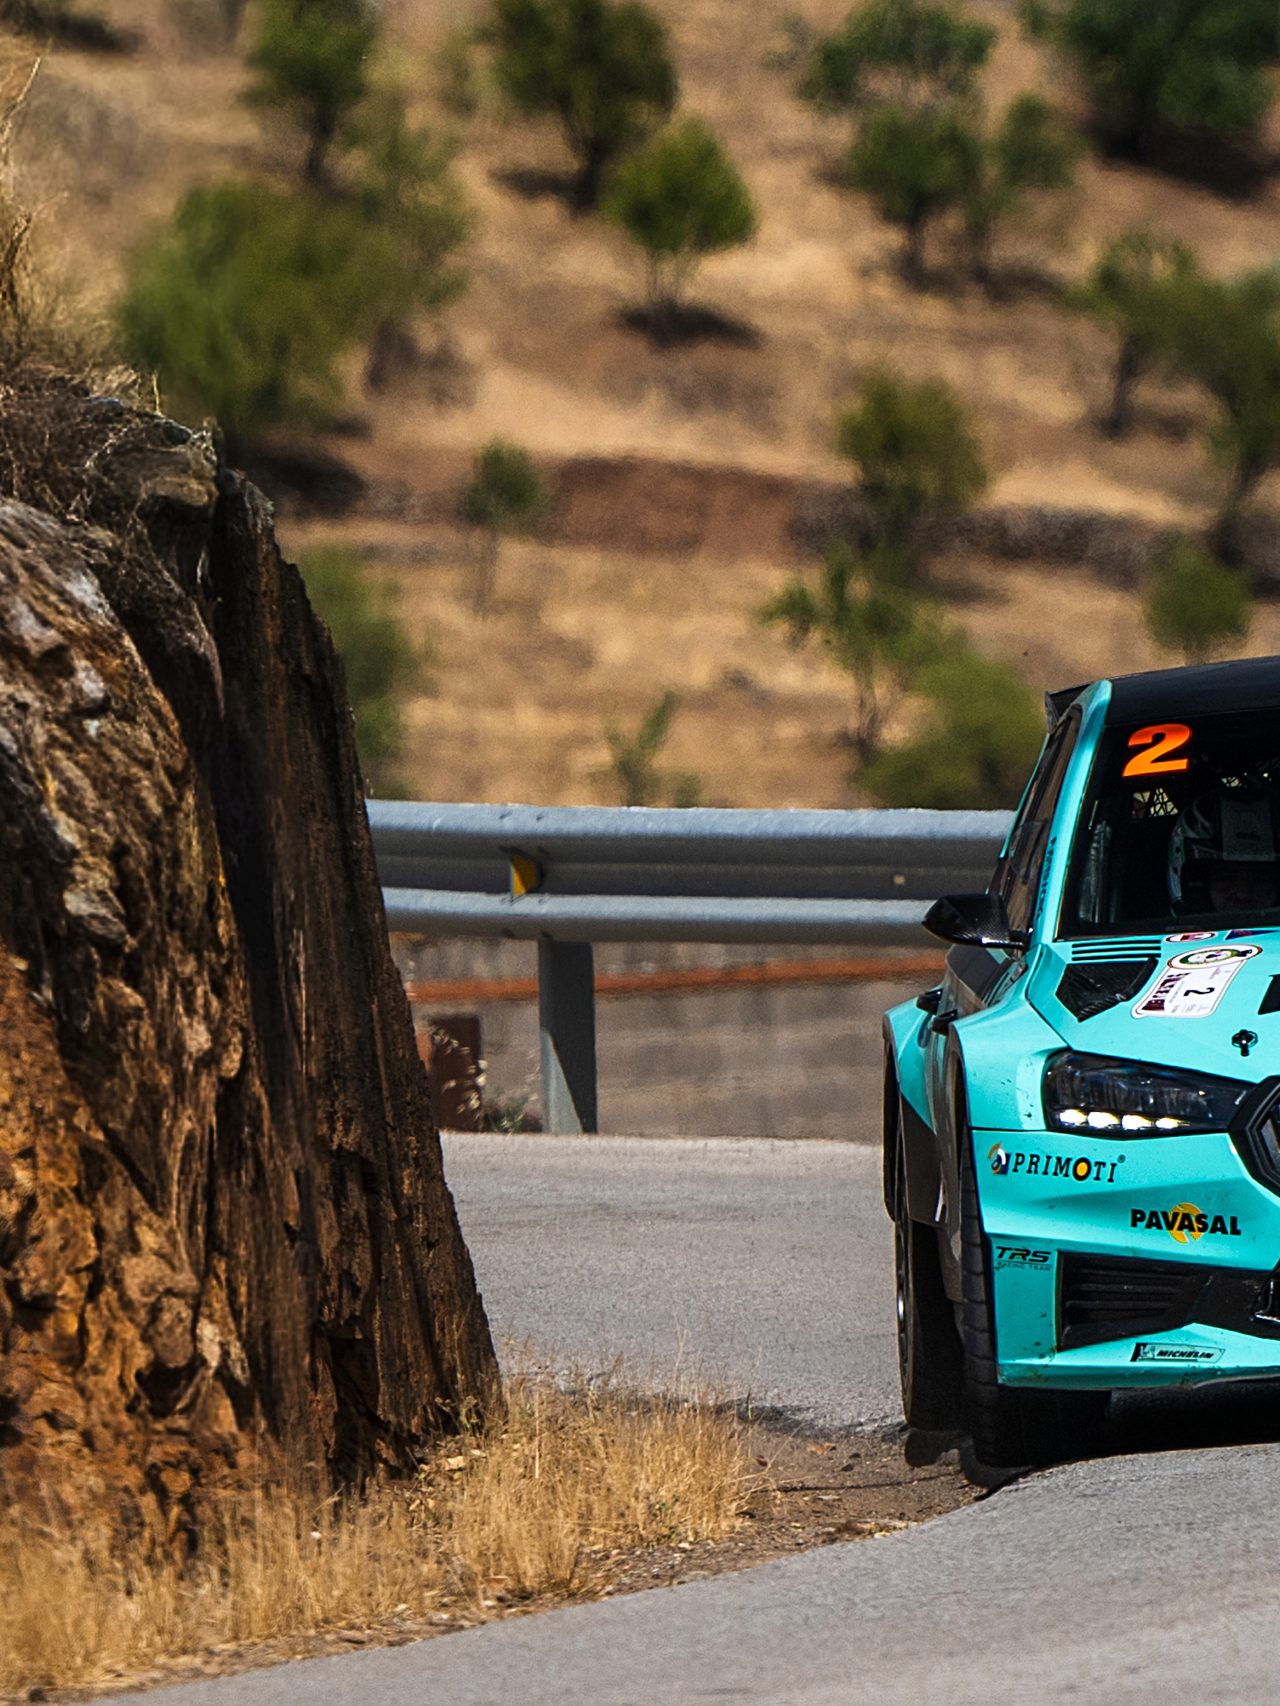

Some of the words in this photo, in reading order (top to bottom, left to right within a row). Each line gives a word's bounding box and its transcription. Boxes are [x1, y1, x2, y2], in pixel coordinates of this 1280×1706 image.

[1121, 722, 1193, 778] 2
[1183, 987, 1215, 997] 2
[1130, 1208, 1242, 1236] PAVASAL
[996, 1245, 1052, 1263] TRS
[1157, 1350, 1215, 1359] MICHELIN
